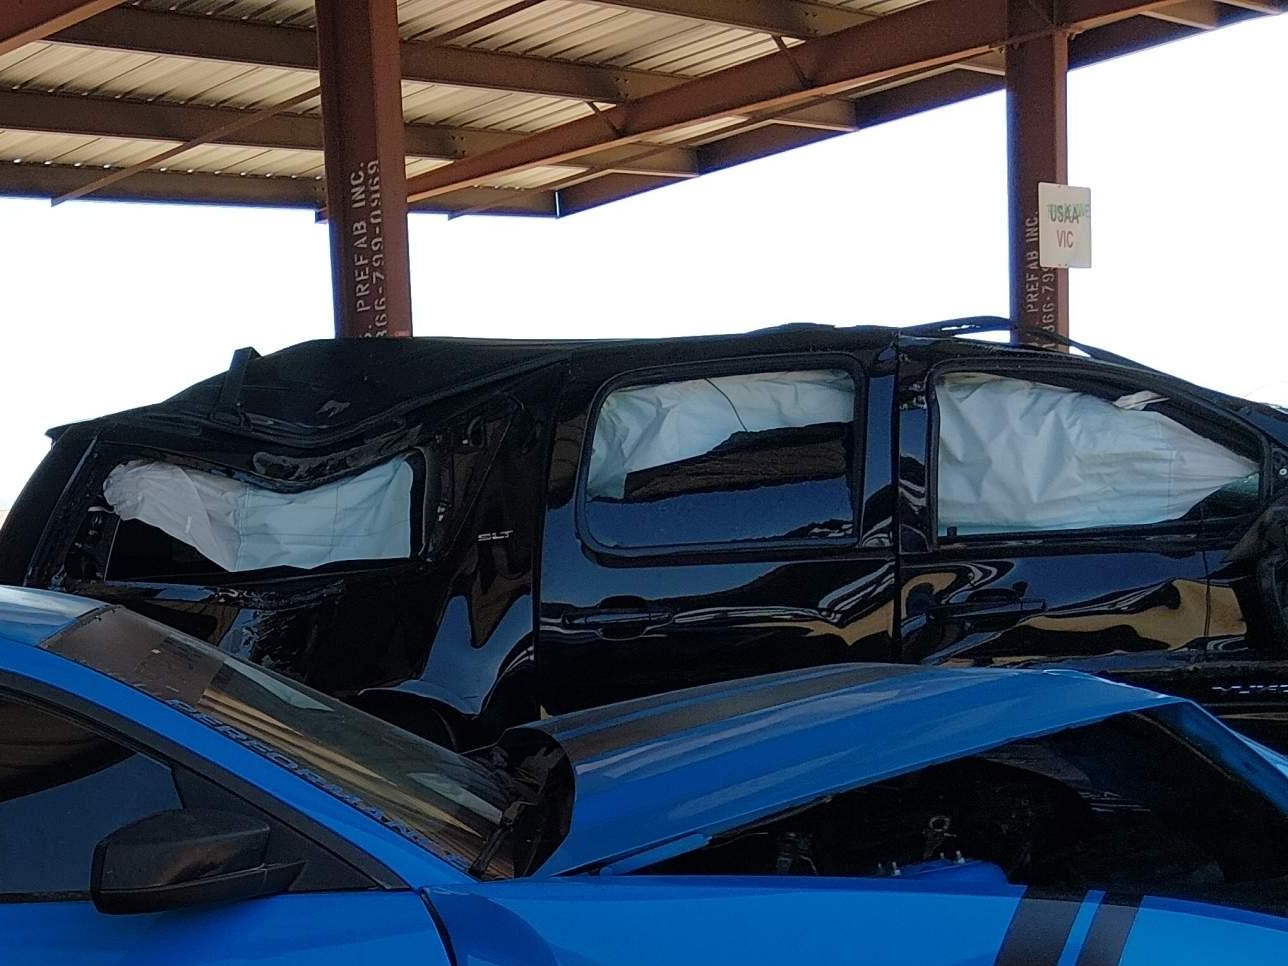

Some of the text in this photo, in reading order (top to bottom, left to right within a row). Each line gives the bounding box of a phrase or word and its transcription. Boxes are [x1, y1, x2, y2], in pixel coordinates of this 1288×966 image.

[350, 161, 366, 208] INC.
[1024, 211, 1039, 243] INC.
[1056, 229, 1074, 249] VIC
[353, 221, 371, 312] PREFAB
[1025, 251, 1040, 312] PREFAB
[477, 529, 514, 542] SLT
